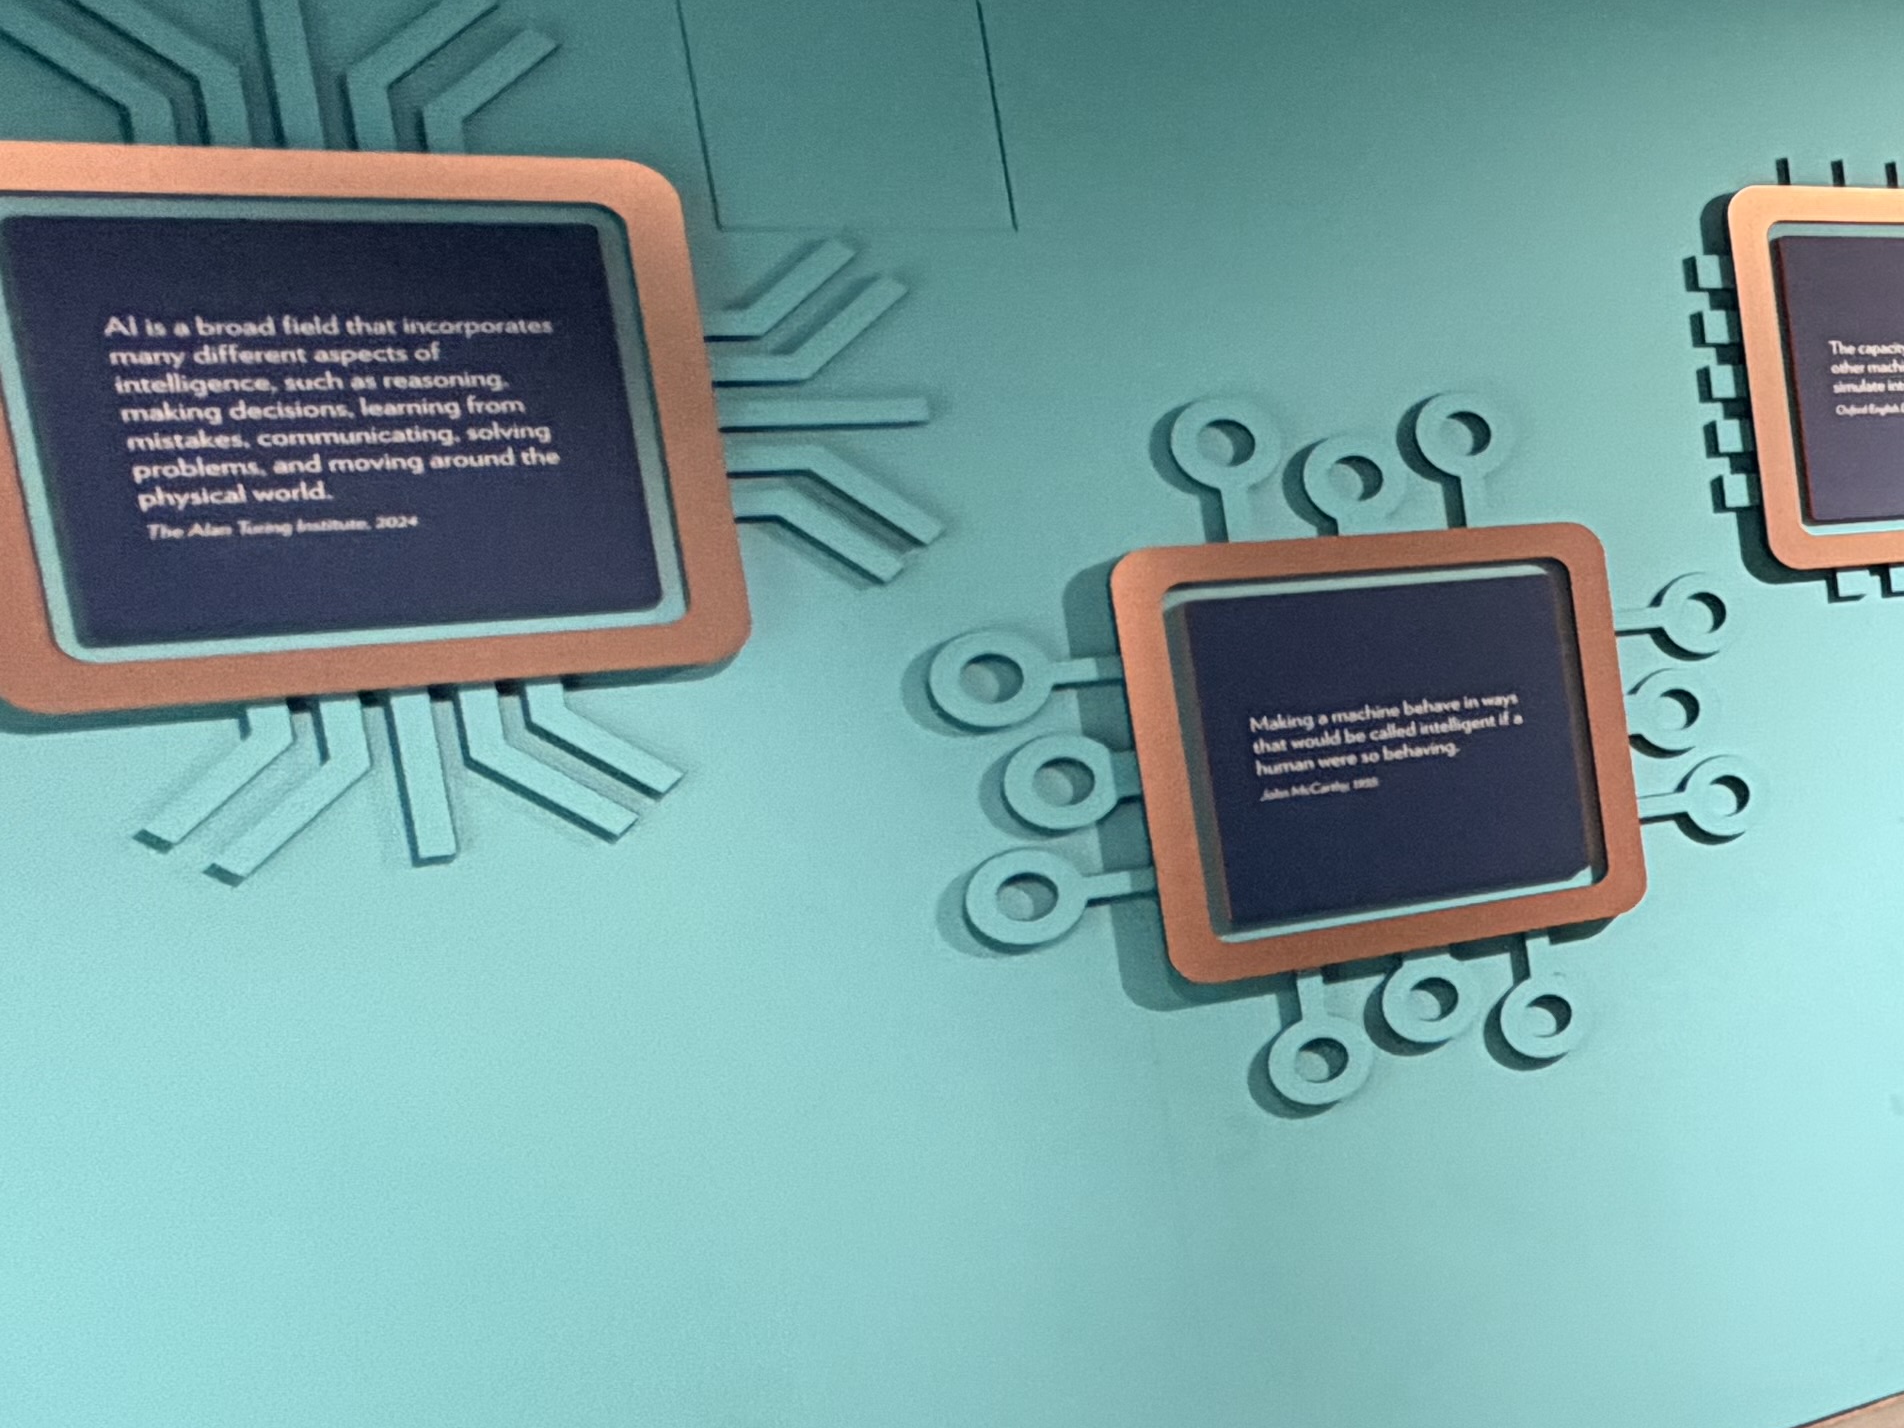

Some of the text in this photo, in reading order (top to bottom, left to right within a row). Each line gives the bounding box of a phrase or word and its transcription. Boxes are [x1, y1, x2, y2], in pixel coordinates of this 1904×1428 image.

[104, 315, 552, 338] AI is a broad field that incorporates
[109, 341, 440, 369] many different aspects of
[115, 373, 277, 398] intelligence,
[284, 371, 344, 391] such
[351, 376, 376, 390] as
[121, 401, 222, 425] making
[359, 397, 461, 419] learning
[467, 395, 525, 414] from
[466, 422, 551, 443] solving
[273, 454, 322, 474] and
[328, 454, 424, 474] moving
[430, 447, 515, 468] around
[521, 447, 560, 465] the
[138, 480, 333, 512] physical world.
[147, 524, 184, 540] The
[188, 523, 232, 537] Alan
[238, 520, 293, 536] Turing
[1250, 694, 1518, 732] Making a machine behave in ways
[1253, 710, 1523, 754] that would be called intelligent if a
[1256, 760, 1314, 776] human
[1318, 754, 1357, 768] were
[1361, 752, 1380, 763] so
